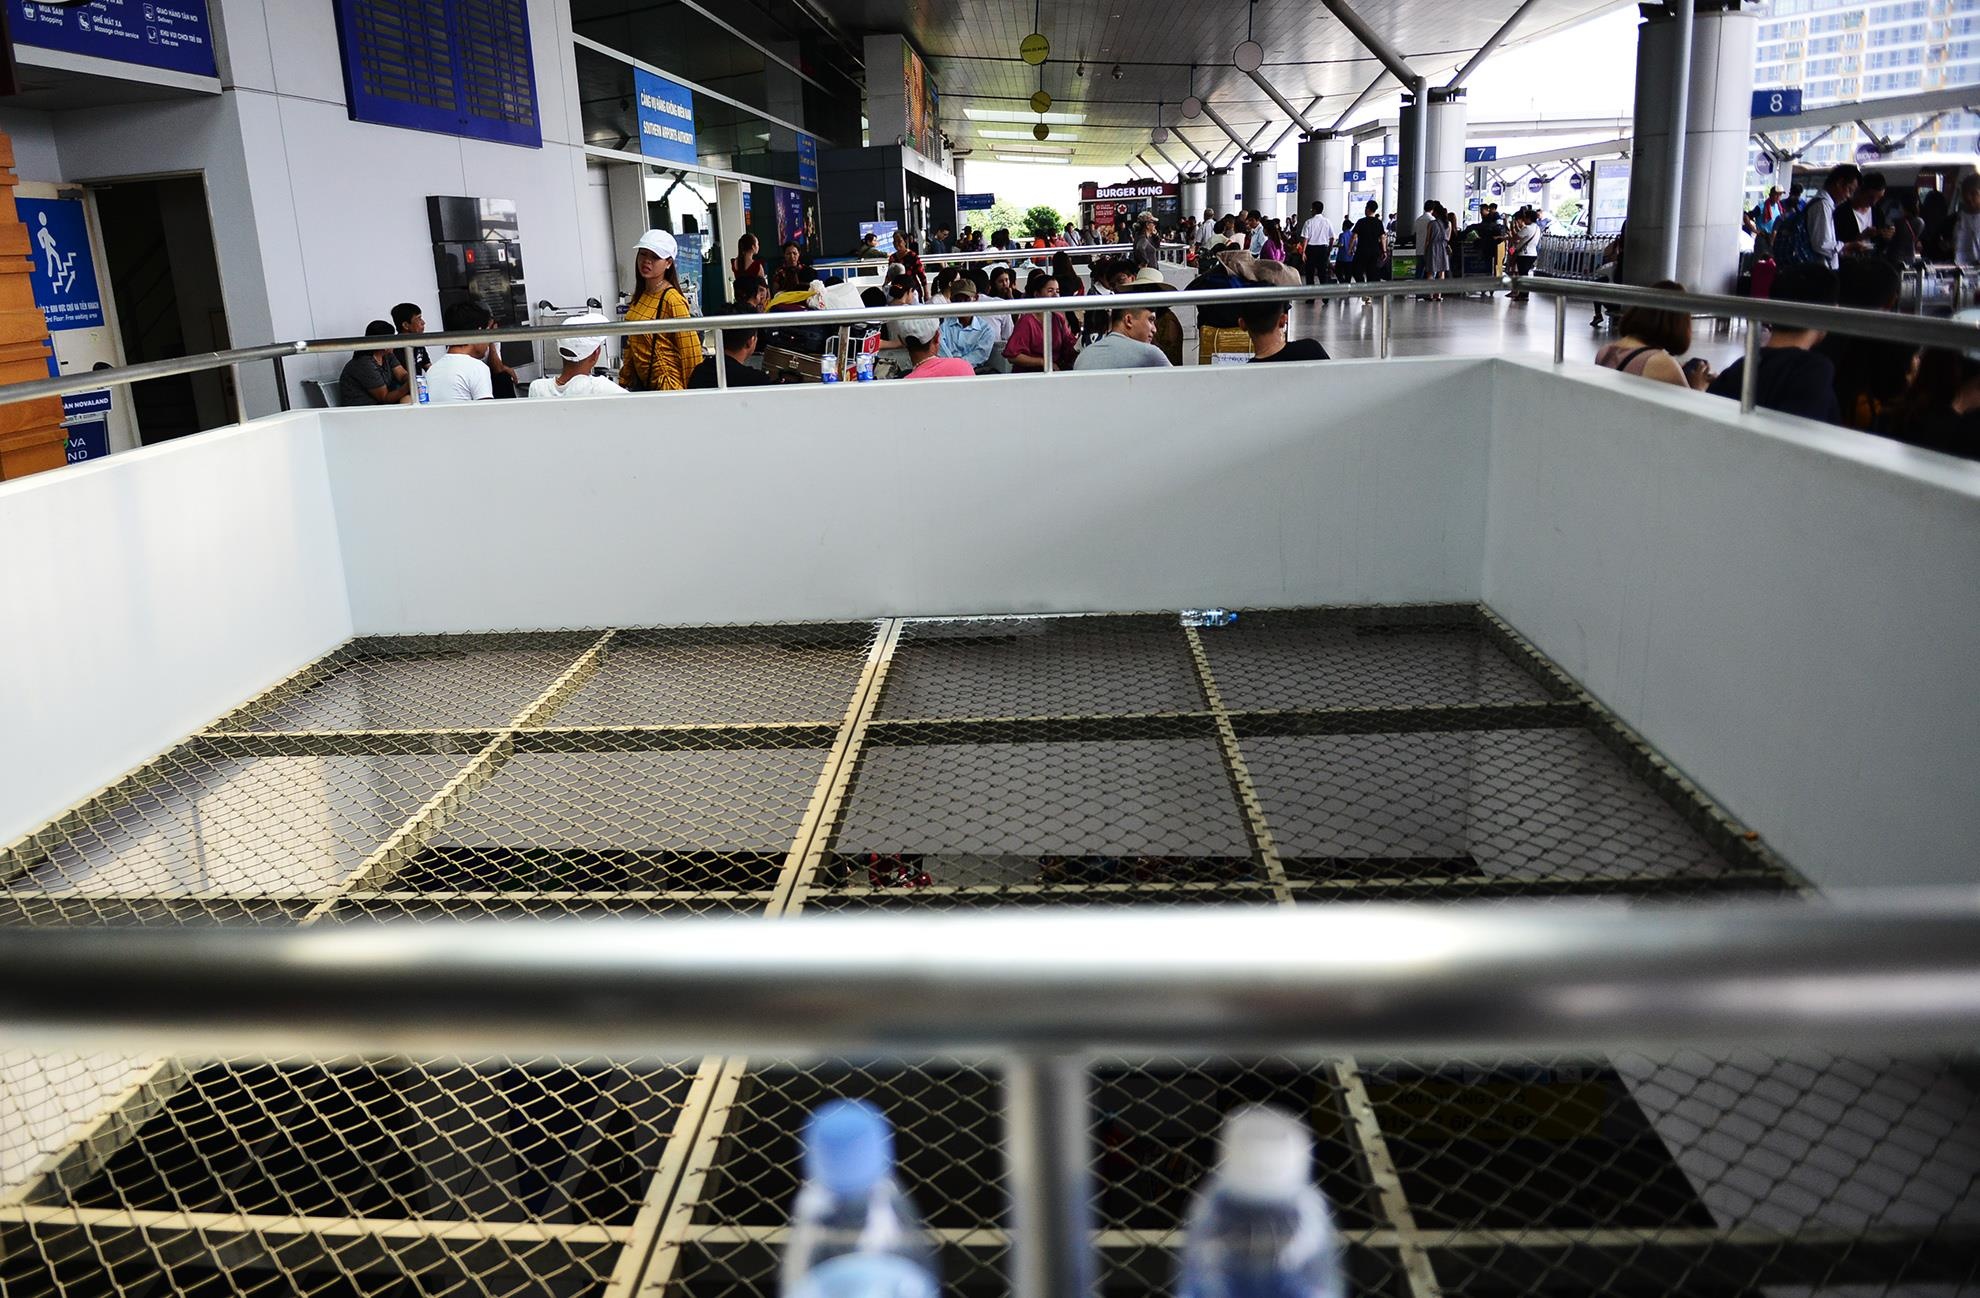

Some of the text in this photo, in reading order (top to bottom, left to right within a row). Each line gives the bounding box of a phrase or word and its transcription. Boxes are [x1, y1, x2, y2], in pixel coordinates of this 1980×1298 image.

[1770, 94, 1782, 112] 8
[1477, 148, 1486, 160] 7
[1096, 186, 1163, 198] BURGER KING
[1284, 185, 1289, 193] 5
[75, 398, 109, 408] NOVALAND
